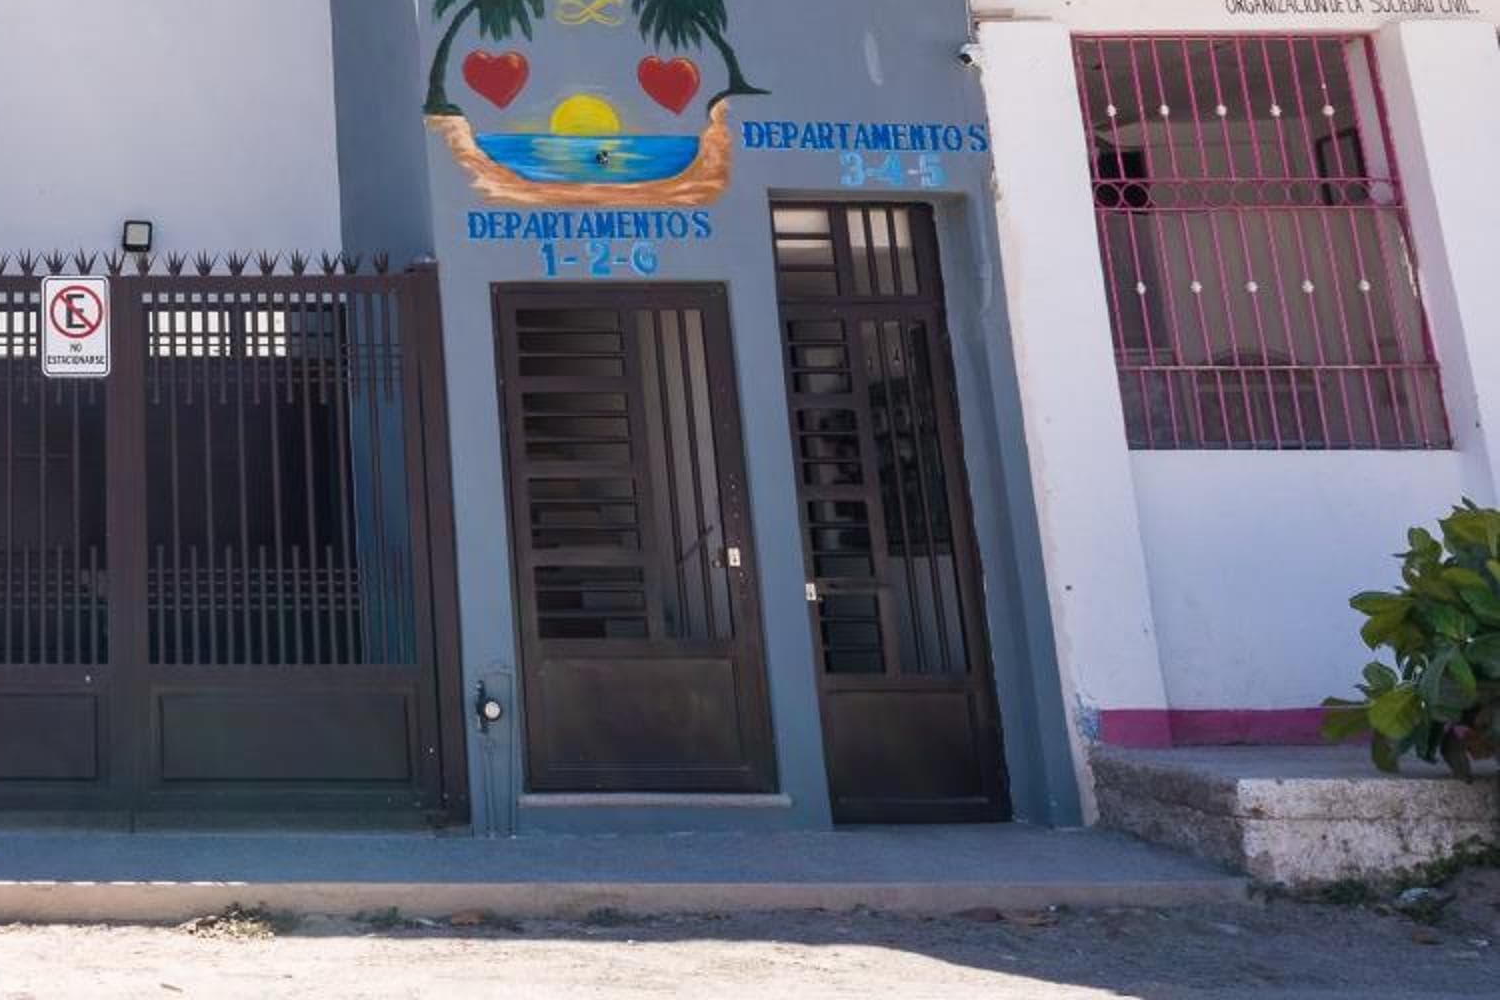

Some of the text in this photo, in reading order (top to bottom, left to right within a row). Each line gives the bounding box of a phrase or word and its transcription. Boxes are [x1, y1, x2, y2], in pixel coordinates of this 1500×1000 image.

[743, 121, 988, 151] DEPARTAMENTOS
[839, 151, 947, 186] 3-4-5
[467, 211, 712, 239] DEPARTAMENTOS
[66, 294, 85, 328] E
[47, 355, 105, 365] ESTACIONARSE
[70, 344, 82, 352] NO
